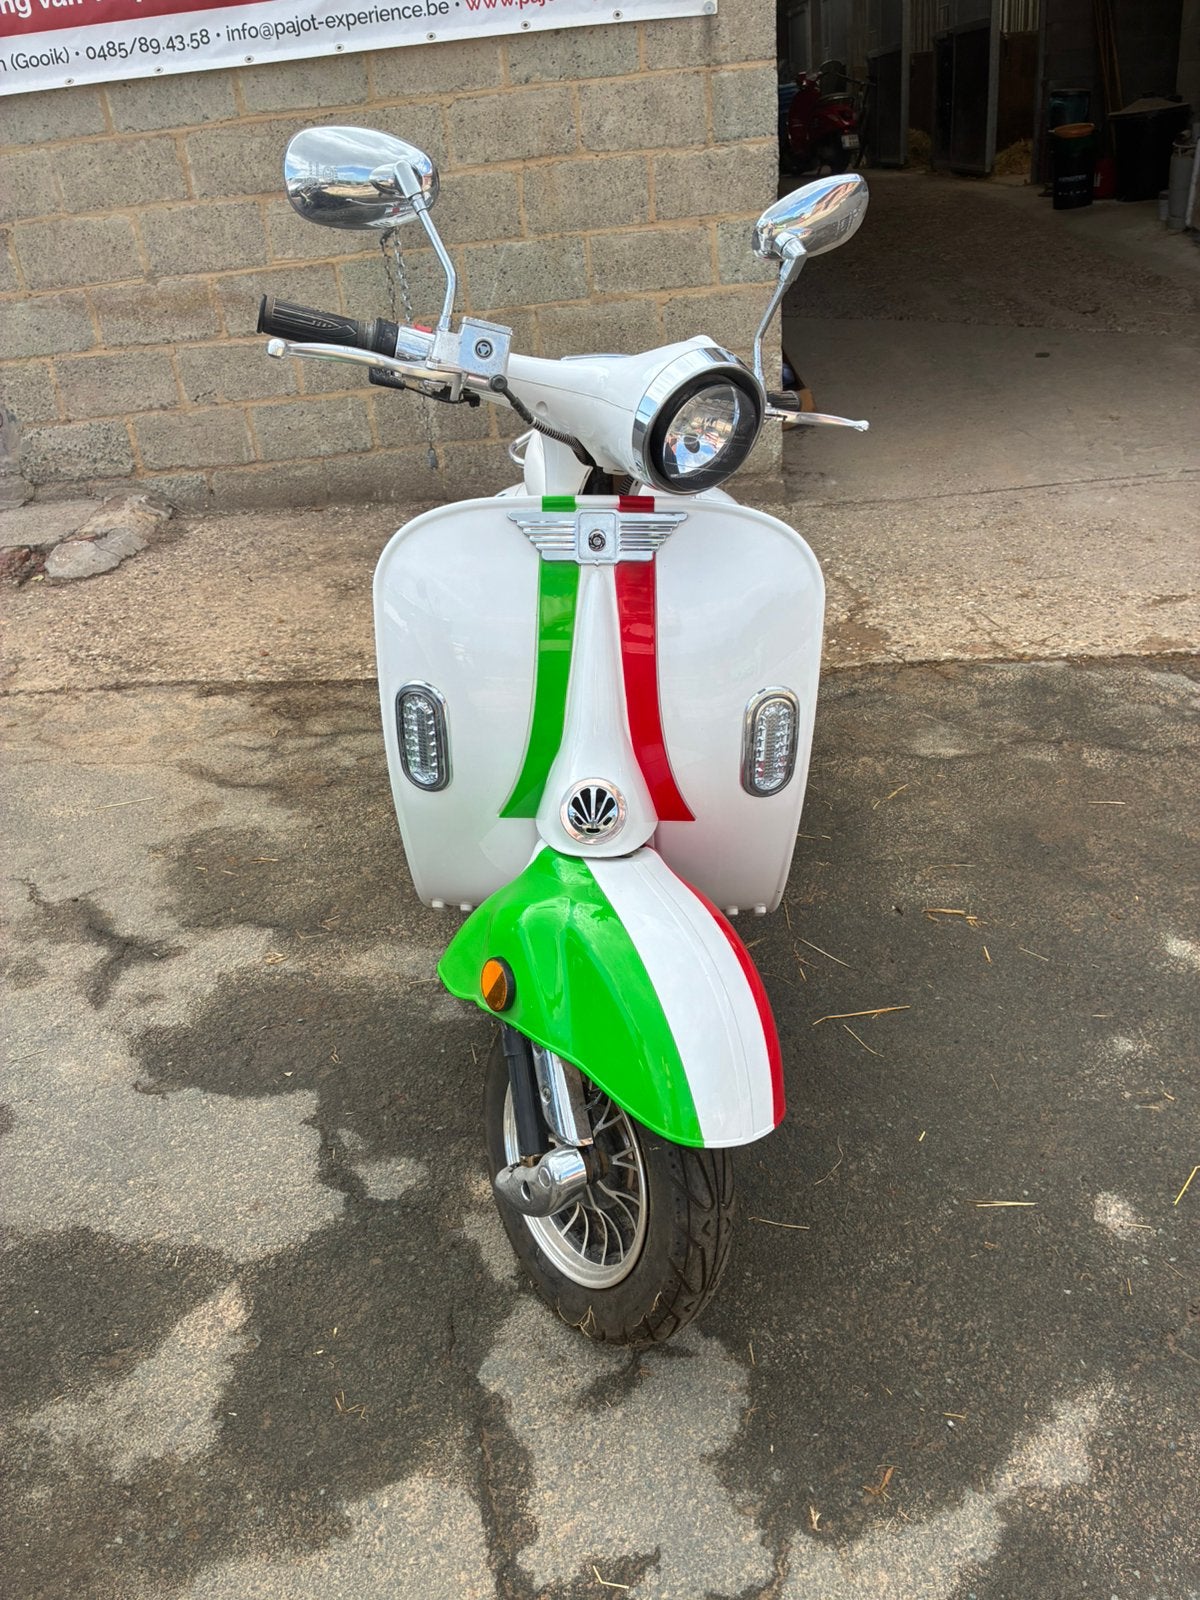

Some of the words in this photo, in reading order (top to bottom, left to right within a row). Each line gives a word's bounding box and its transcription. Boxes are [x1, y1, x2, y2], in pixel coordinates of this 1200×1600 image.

[10, 46, 70, 71] (Gooik)
[85, 28, 211, 61] 0485/89.43.58
[226, 0, 450, 42] info@pajot-experience.be
